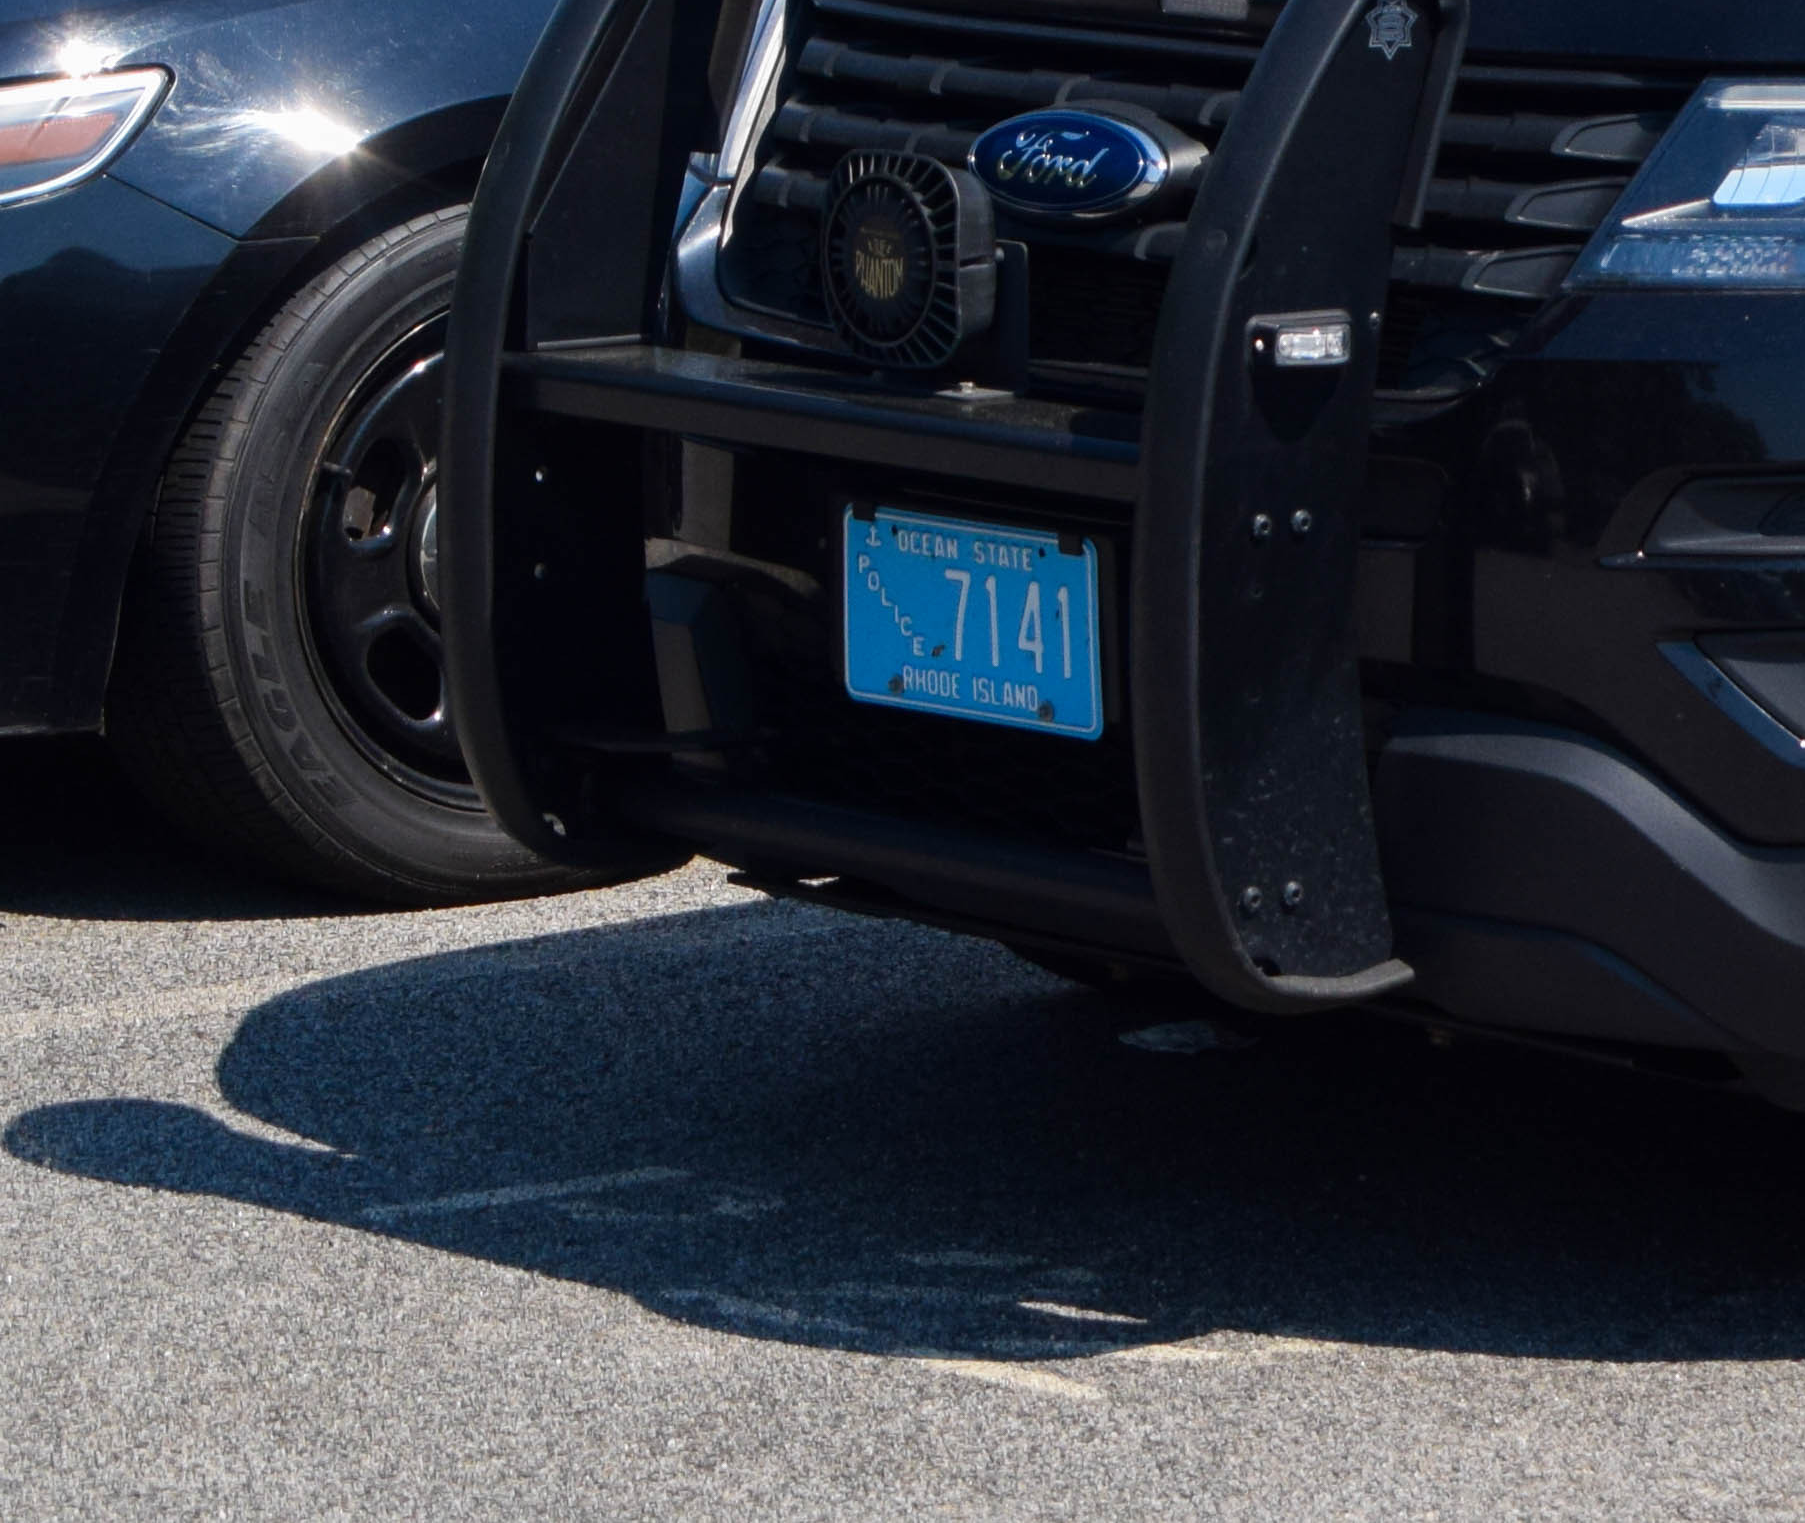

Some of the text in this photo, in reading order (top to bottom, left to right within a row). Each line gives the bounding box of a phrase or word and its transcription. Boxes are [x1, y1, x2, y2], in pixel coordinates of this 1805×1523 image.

[997, 129, 1110, 188] Ford
[855, 249, 905, 299] PHANTOM
[898, 529, 1033, 572] OCEAN STATE
[857, 554, 926, 657] POLICE
[945, 568, 1073, 680] 7141
[902, 665, 1039, 712] RHODE ISLAND
